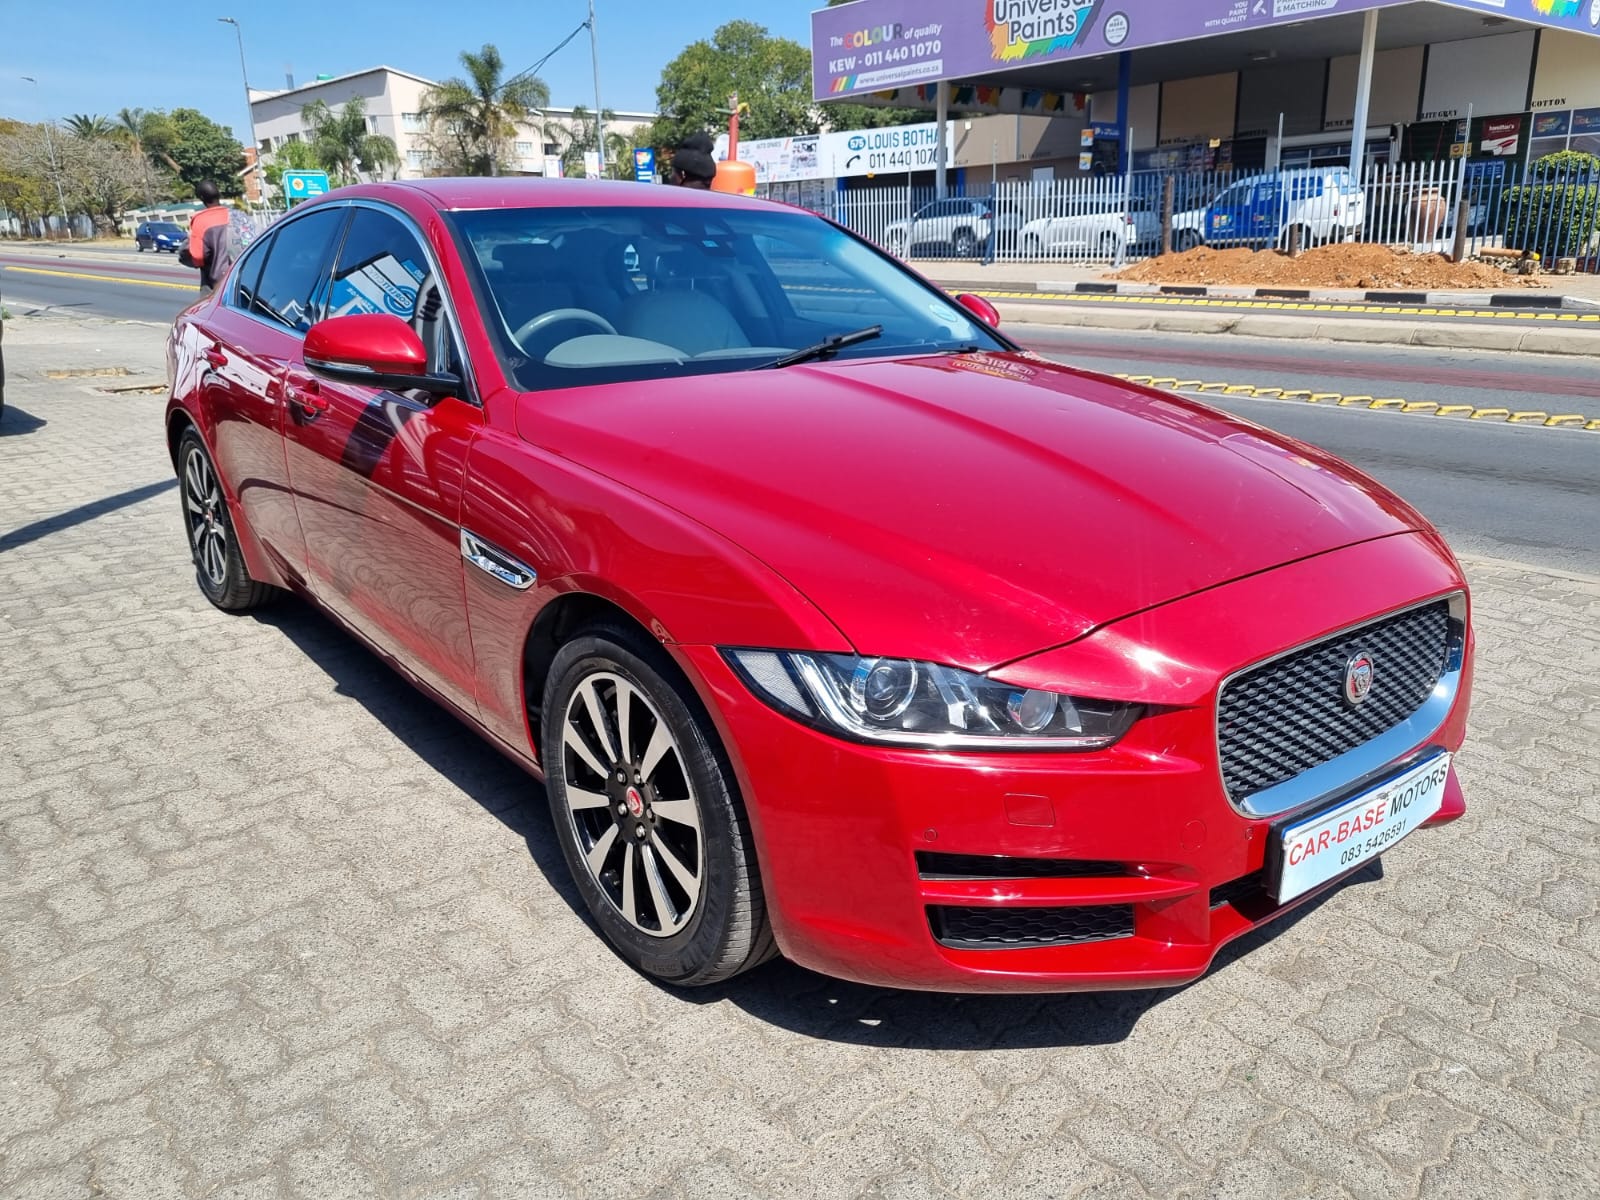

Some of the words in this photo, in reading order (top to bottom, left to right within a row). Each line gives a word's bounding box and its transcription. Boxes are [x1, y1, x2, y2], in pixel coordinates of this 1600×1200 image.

[996, 0, 1092, 21] Univers
[1229, 8, 1247, 16] PAINT
[1283, 0, 1327, 12] MATCHING
[1010, 12, 1075, 42] Paints
[1205, 19, 1220, 27] WITH
[1221, 15, 1247, 25] QUALITY
[830, 36, 843, 47] The
[844, 22, 903, 49] COLOUR
[904, 27, 914, 40] of
[914, 23, 942, 39] quality
[829, 56, 856, 74] KEW
[865, 51, 882, 66] 011
[885, 46, 908, 63] 440
[911, 40, 941, 57] 1070
[1531, 97, 1566, 107] COTTON
[868, 131, 899, 149] LOUIS
[869, 152, 886, 168] 011
[890, 149, 911, 167] 440
[1289, 801, 1386, 866] CAR-BASE
[1390, 763, 1447, 817] MOTORS
[1341, 844, 1361, 865] 083
[1365, 819, 1407, 851] 5426591
